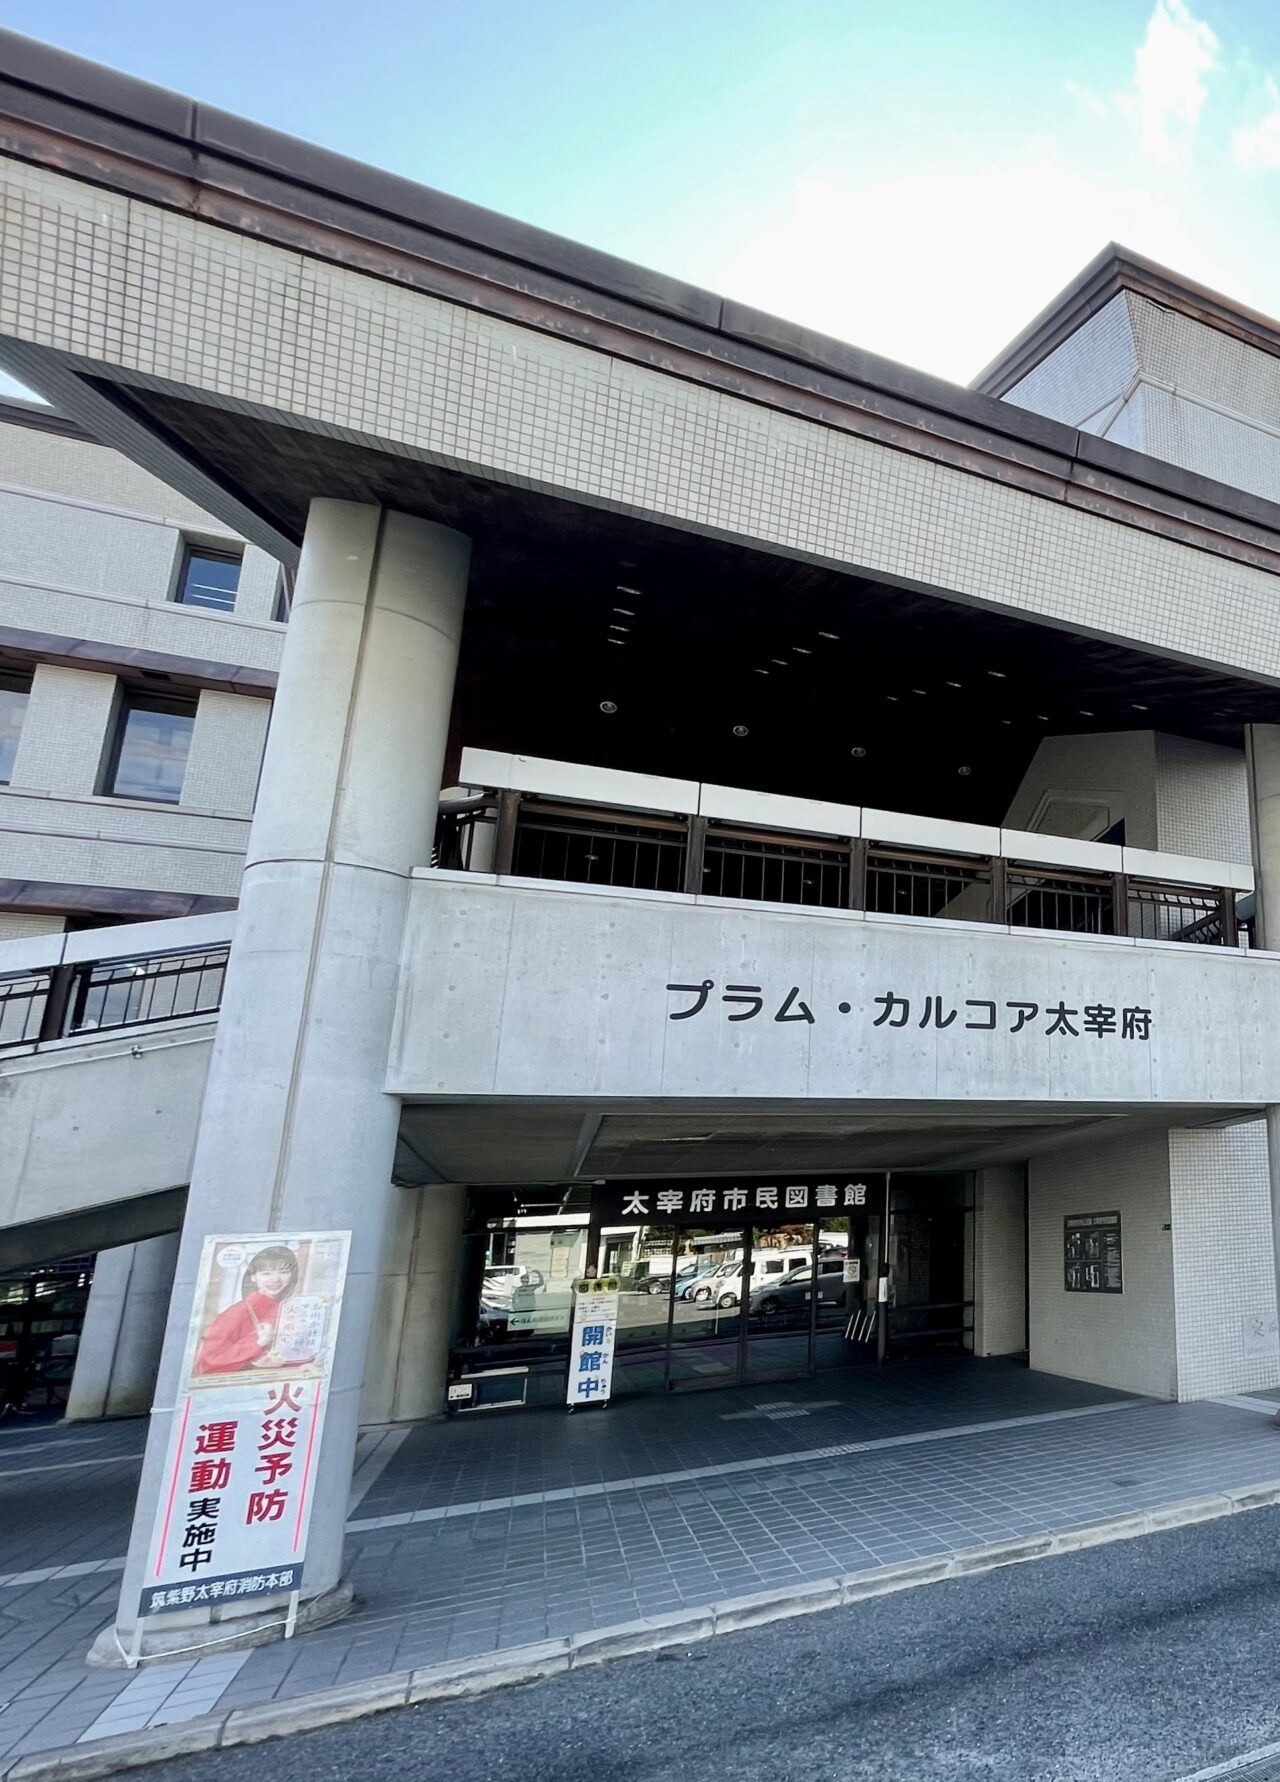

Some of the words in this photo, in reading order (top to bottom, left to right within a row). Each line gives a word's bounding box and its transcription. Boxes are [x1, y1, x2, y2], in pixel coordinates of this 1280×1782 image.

[666, 979, 1153, 1040] プラム・カルコア太宰府
[621, 1183, 867, 1215] 太宰府市民図書館
[577, 1325, 605, 1398] 開館中
[246, 1383, 303, 1525] 火災予防
[179, 1420, 239, 1572] 運動実施中
[149, 1570, 294, 1609] 筑紫野太宰府消防本部
